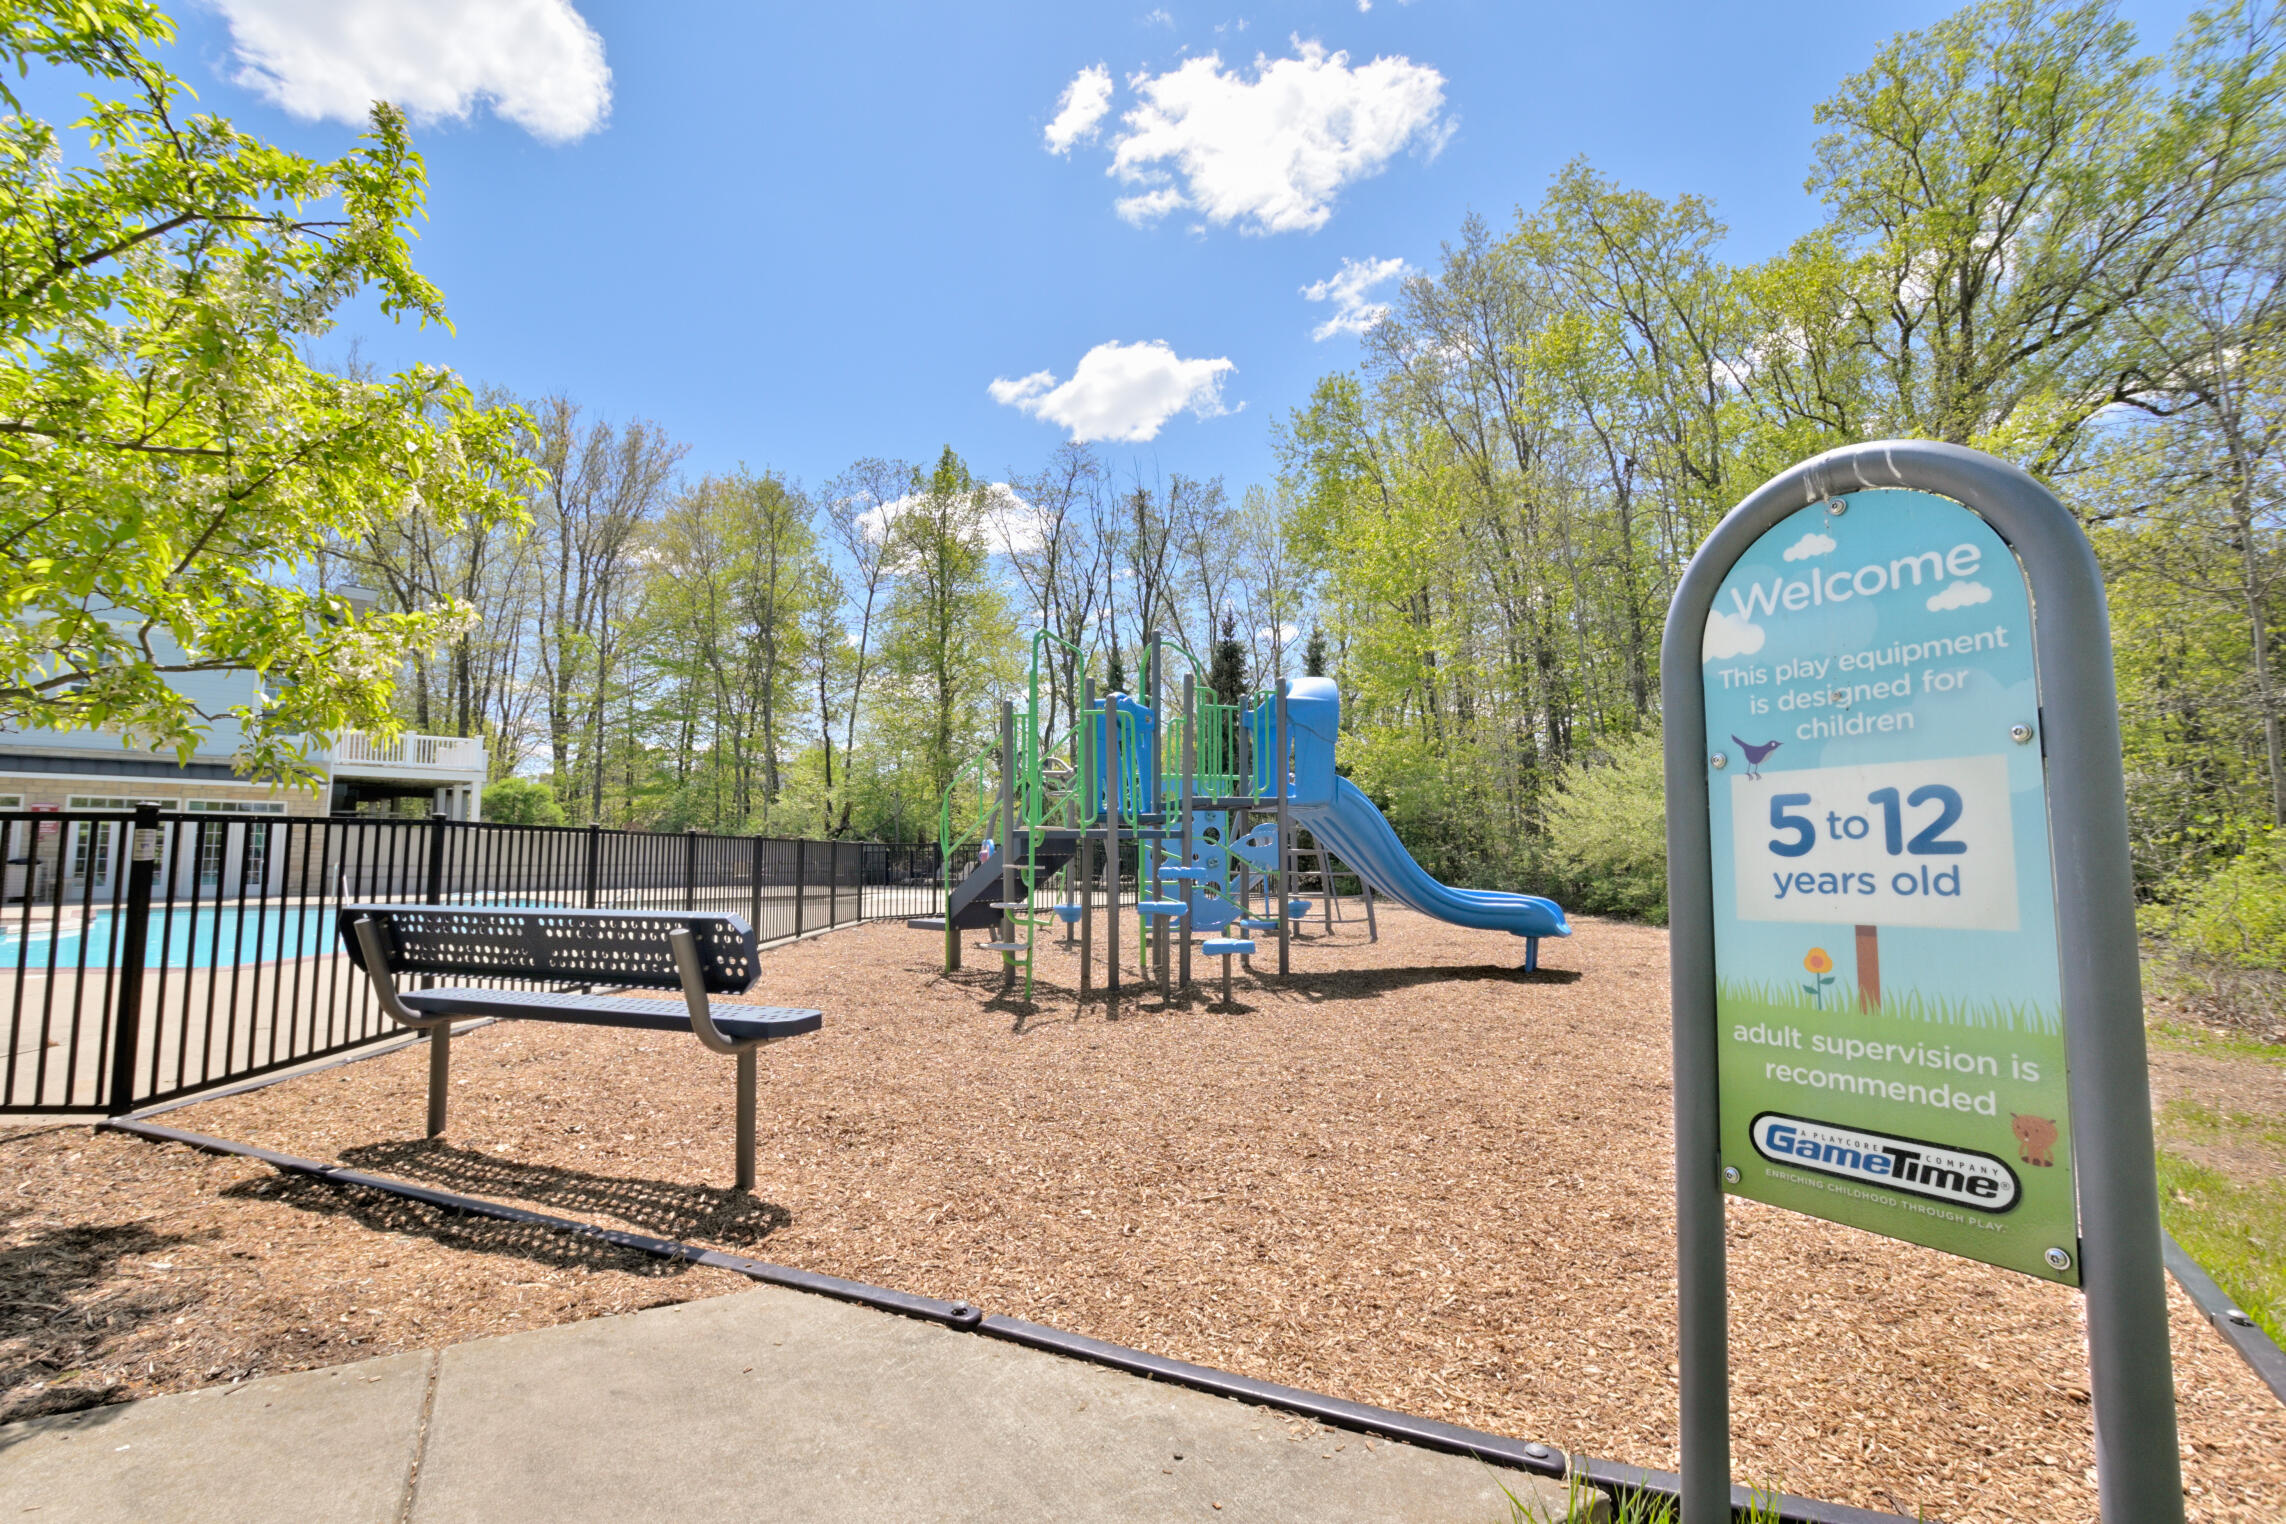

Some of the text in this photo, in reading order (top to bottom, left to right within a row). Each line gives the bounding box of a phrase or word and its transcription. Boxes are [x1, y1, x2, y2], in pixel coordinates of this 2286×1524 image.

[1731, 544, 1981, 620] Welcome
[1719, 626, 2009, 689] This play equipment
[1750, 669, 1969, 715] is designed for
[1796, 712, 1915, 740] children
[1768, 784, 1968, 857] 5 to 12
[1773, 864, 1961, 899] years old
[1733, 1023, 2040, 1083] adult supervision is
[1765, 1062, 1997, 1116] recommended
[1766, 1123, 1999, 1199] GameTime
[1813, 1132, 1878, 1152] PLAYCORE
[1926, 1155, 1999, 1176] COMPANY
[1765, 1168, 1824, 1190] ENRICHING
[1827, 1183, 1897, 1207] CHILDHOOD
[1902, 1200, 1964, 1224] THROUGH
